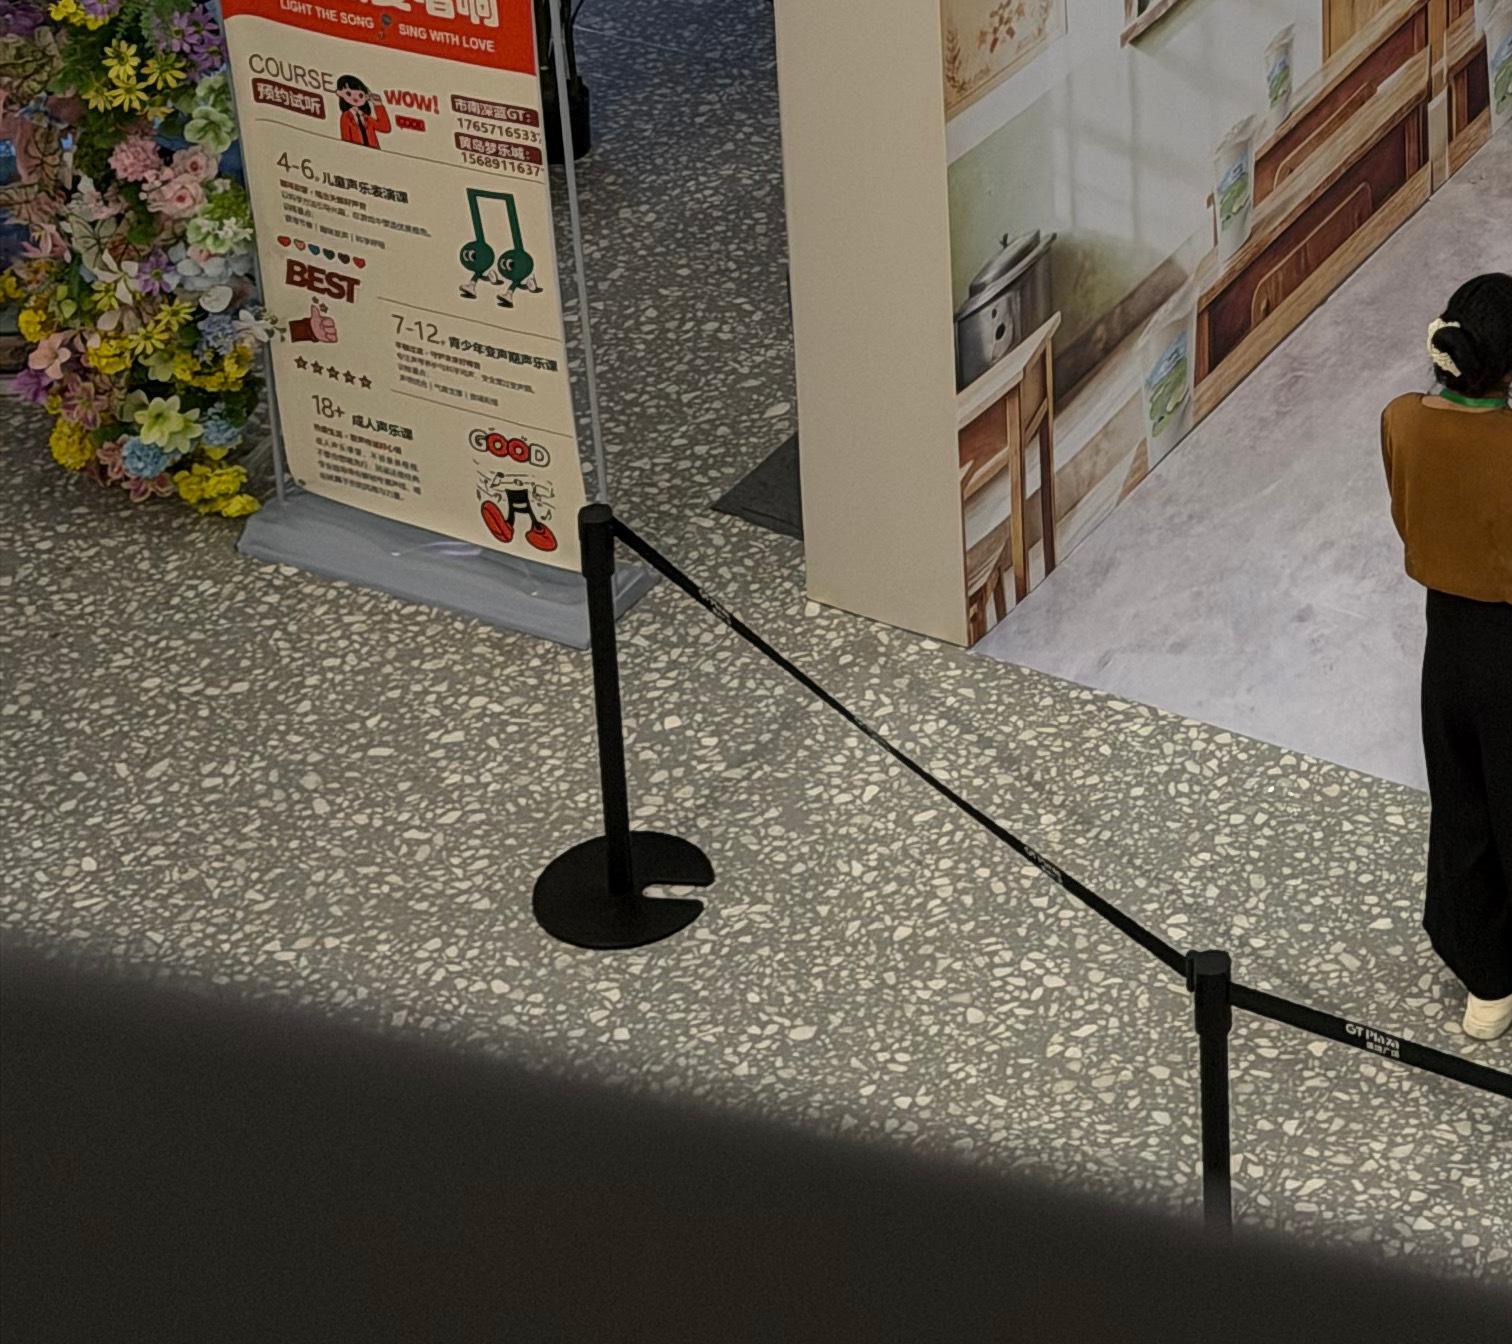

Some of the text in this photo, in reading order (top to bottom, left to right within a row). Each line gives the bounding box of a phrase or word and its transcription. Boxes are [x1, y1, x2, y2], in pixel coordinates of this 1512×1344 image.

[315, 5, 337, 21] THE
[339, 10, 375, 30] SONG
[398, 23, 427, 40] SING
[429, 28, 459, 46] WITH
[462, 35, 495, 53] LOVE
[248, 52, 336, 94] COURSE
[256, 83, 322, 115] 预约试听
[383, 89, 440, 115] WOW!
[461, 151, 544, 177] 1568911637
[285, 258, 361, 303] BEST
[311, 394, 345, 419] 18+
[468, 428, 551, 468] GOOD
